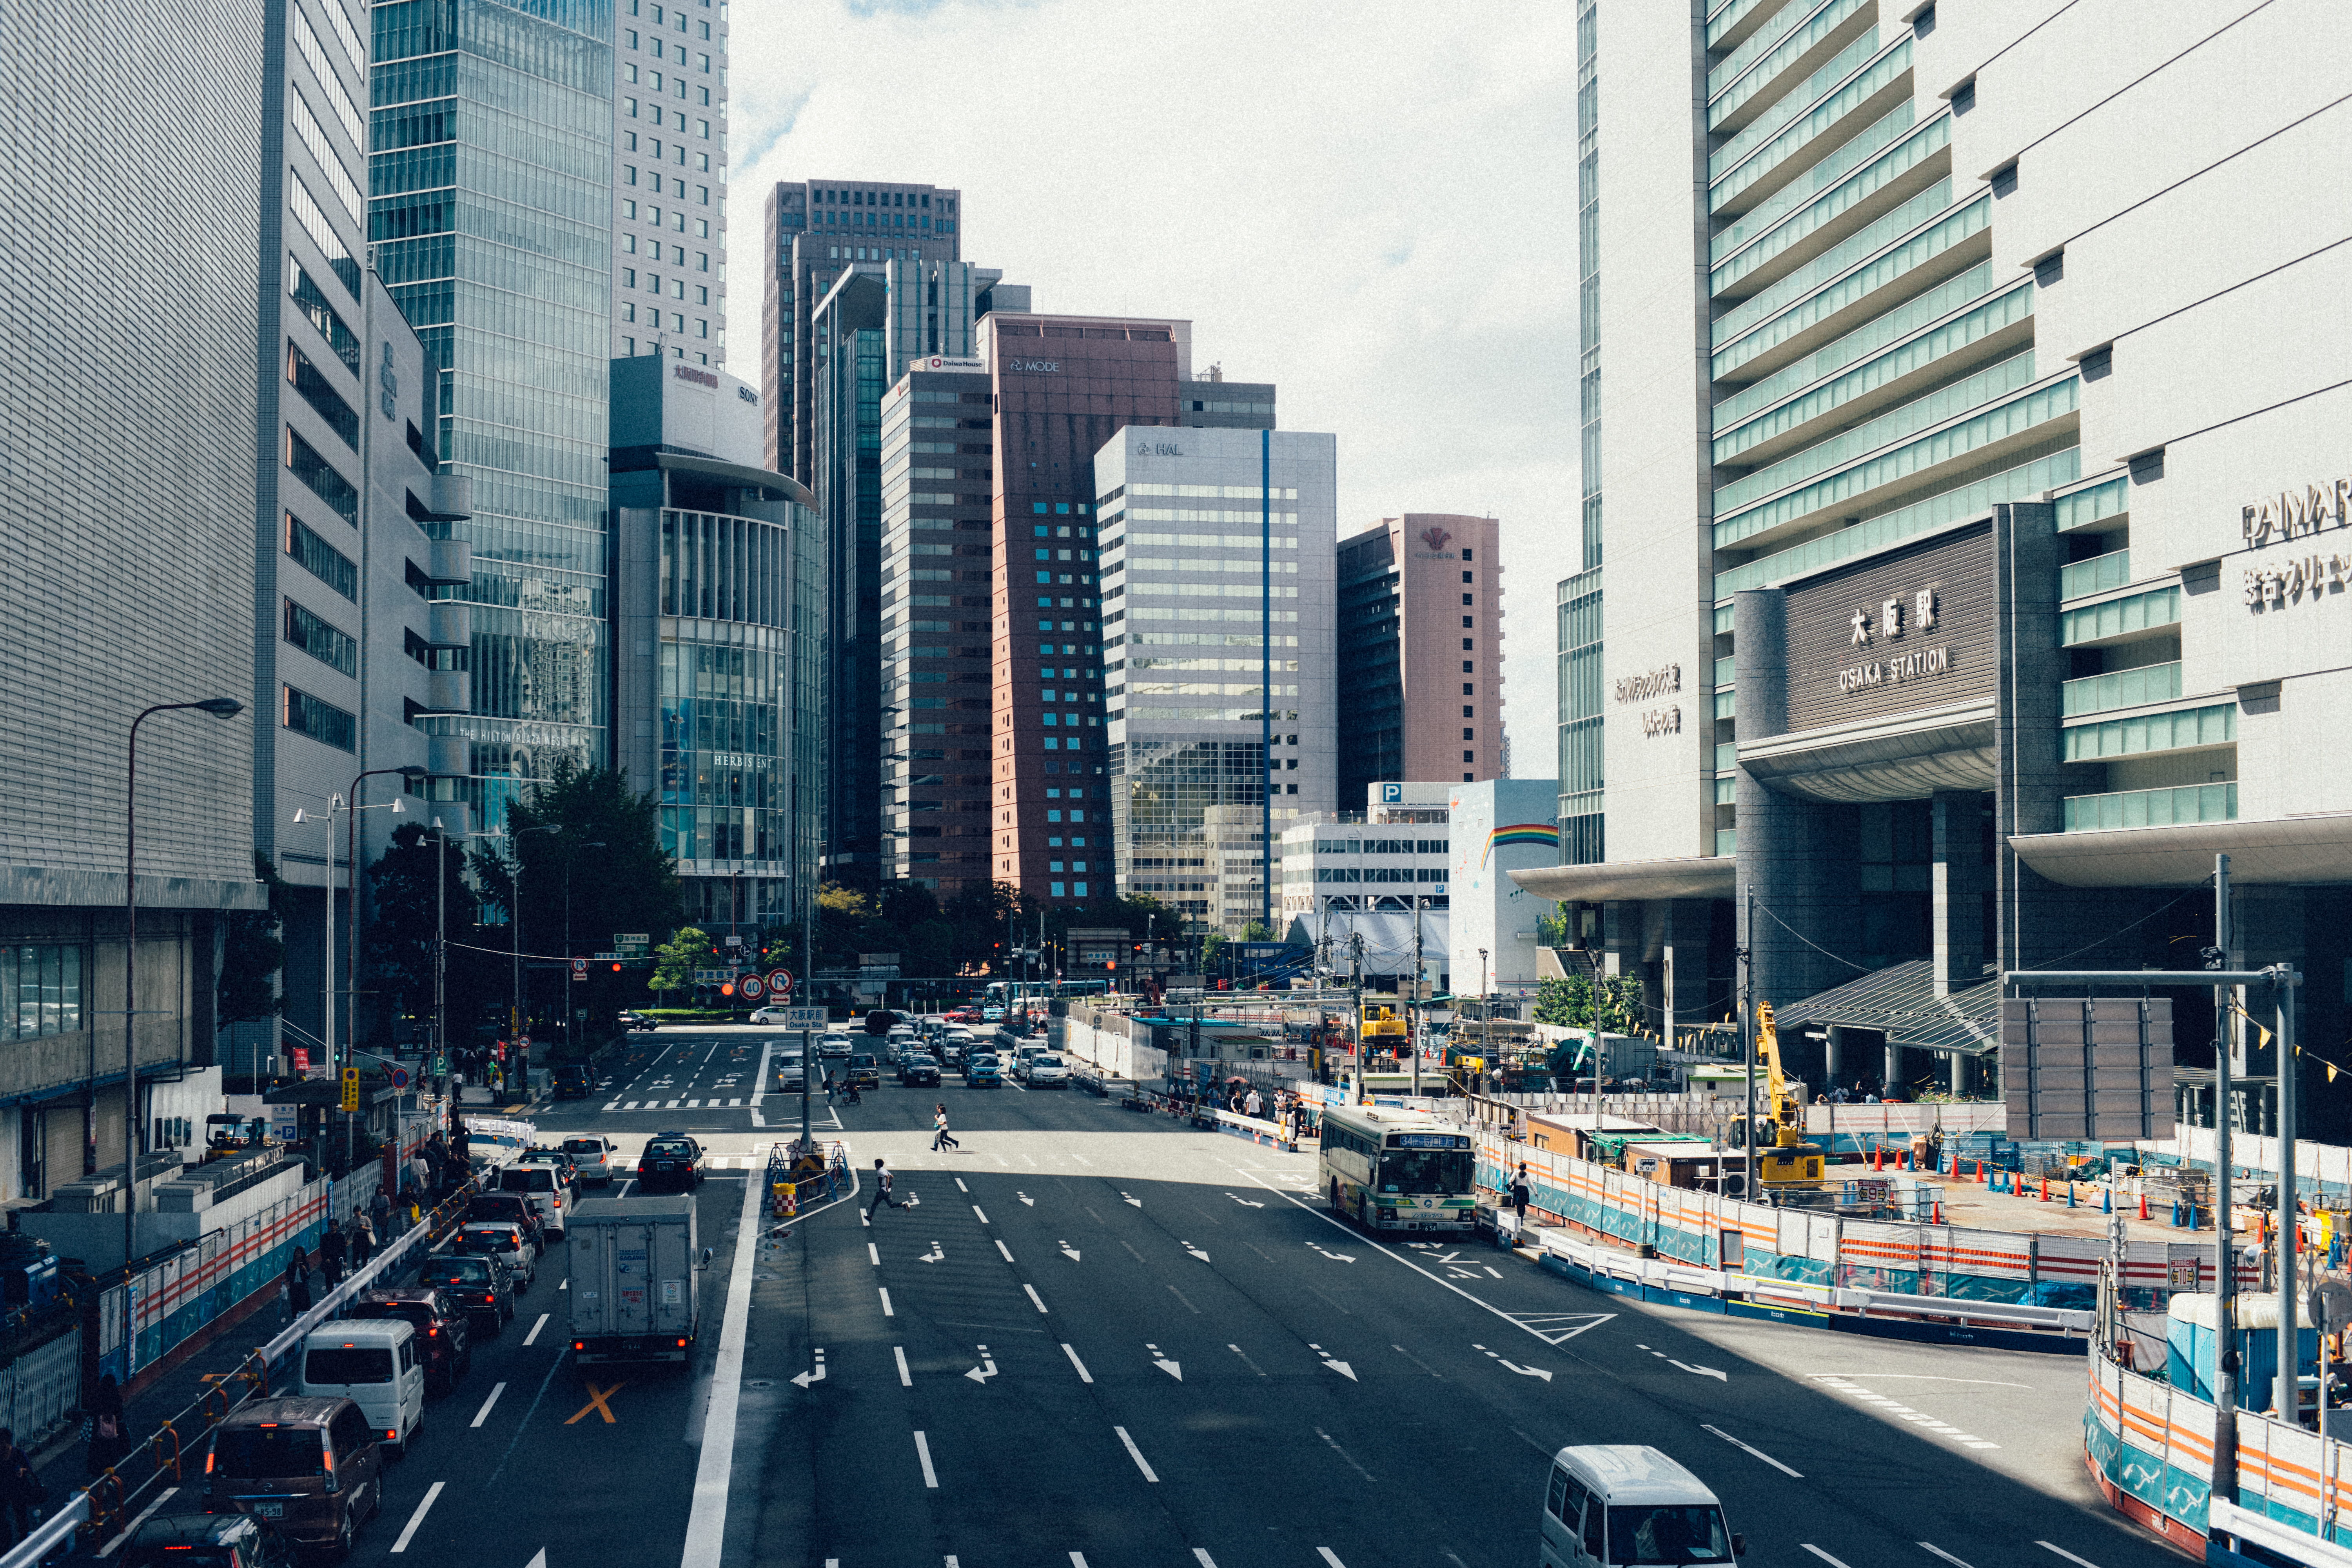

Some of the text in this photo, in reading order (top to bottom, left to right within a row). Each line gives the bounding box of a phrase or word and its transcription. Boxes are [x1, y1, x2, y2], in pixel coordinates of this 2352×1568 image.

[1025, 361, 1059, 372] MODE
[739, 386, 758, 406] SONY
[1156, 443, 1183, 455] HAL
[1851, 589, 1935, 644] 大阪駅
[1840, 647, 1948, 690] OSAKA STATION
[481, 731, 511, 743] HILTON
[516, 733, 541, 745] PLAZA
[714, 755, 752, 767] HERBIS
[1386, 786, 1399, 801] P
[746, 982, 759, 993] 40
[790, 1009, 823, 1020] 大阪駅前
[437, 1058, 444, 1068] P
[286, 1129, 293, 1137] P
[1401, 1136, 1412, 1145] 34
[1425, 1137, 1454, 1147] 守口車庫
[1869, 1187, 1877, 1200] 9
[2180, 1269, 2186, 1285] 10
